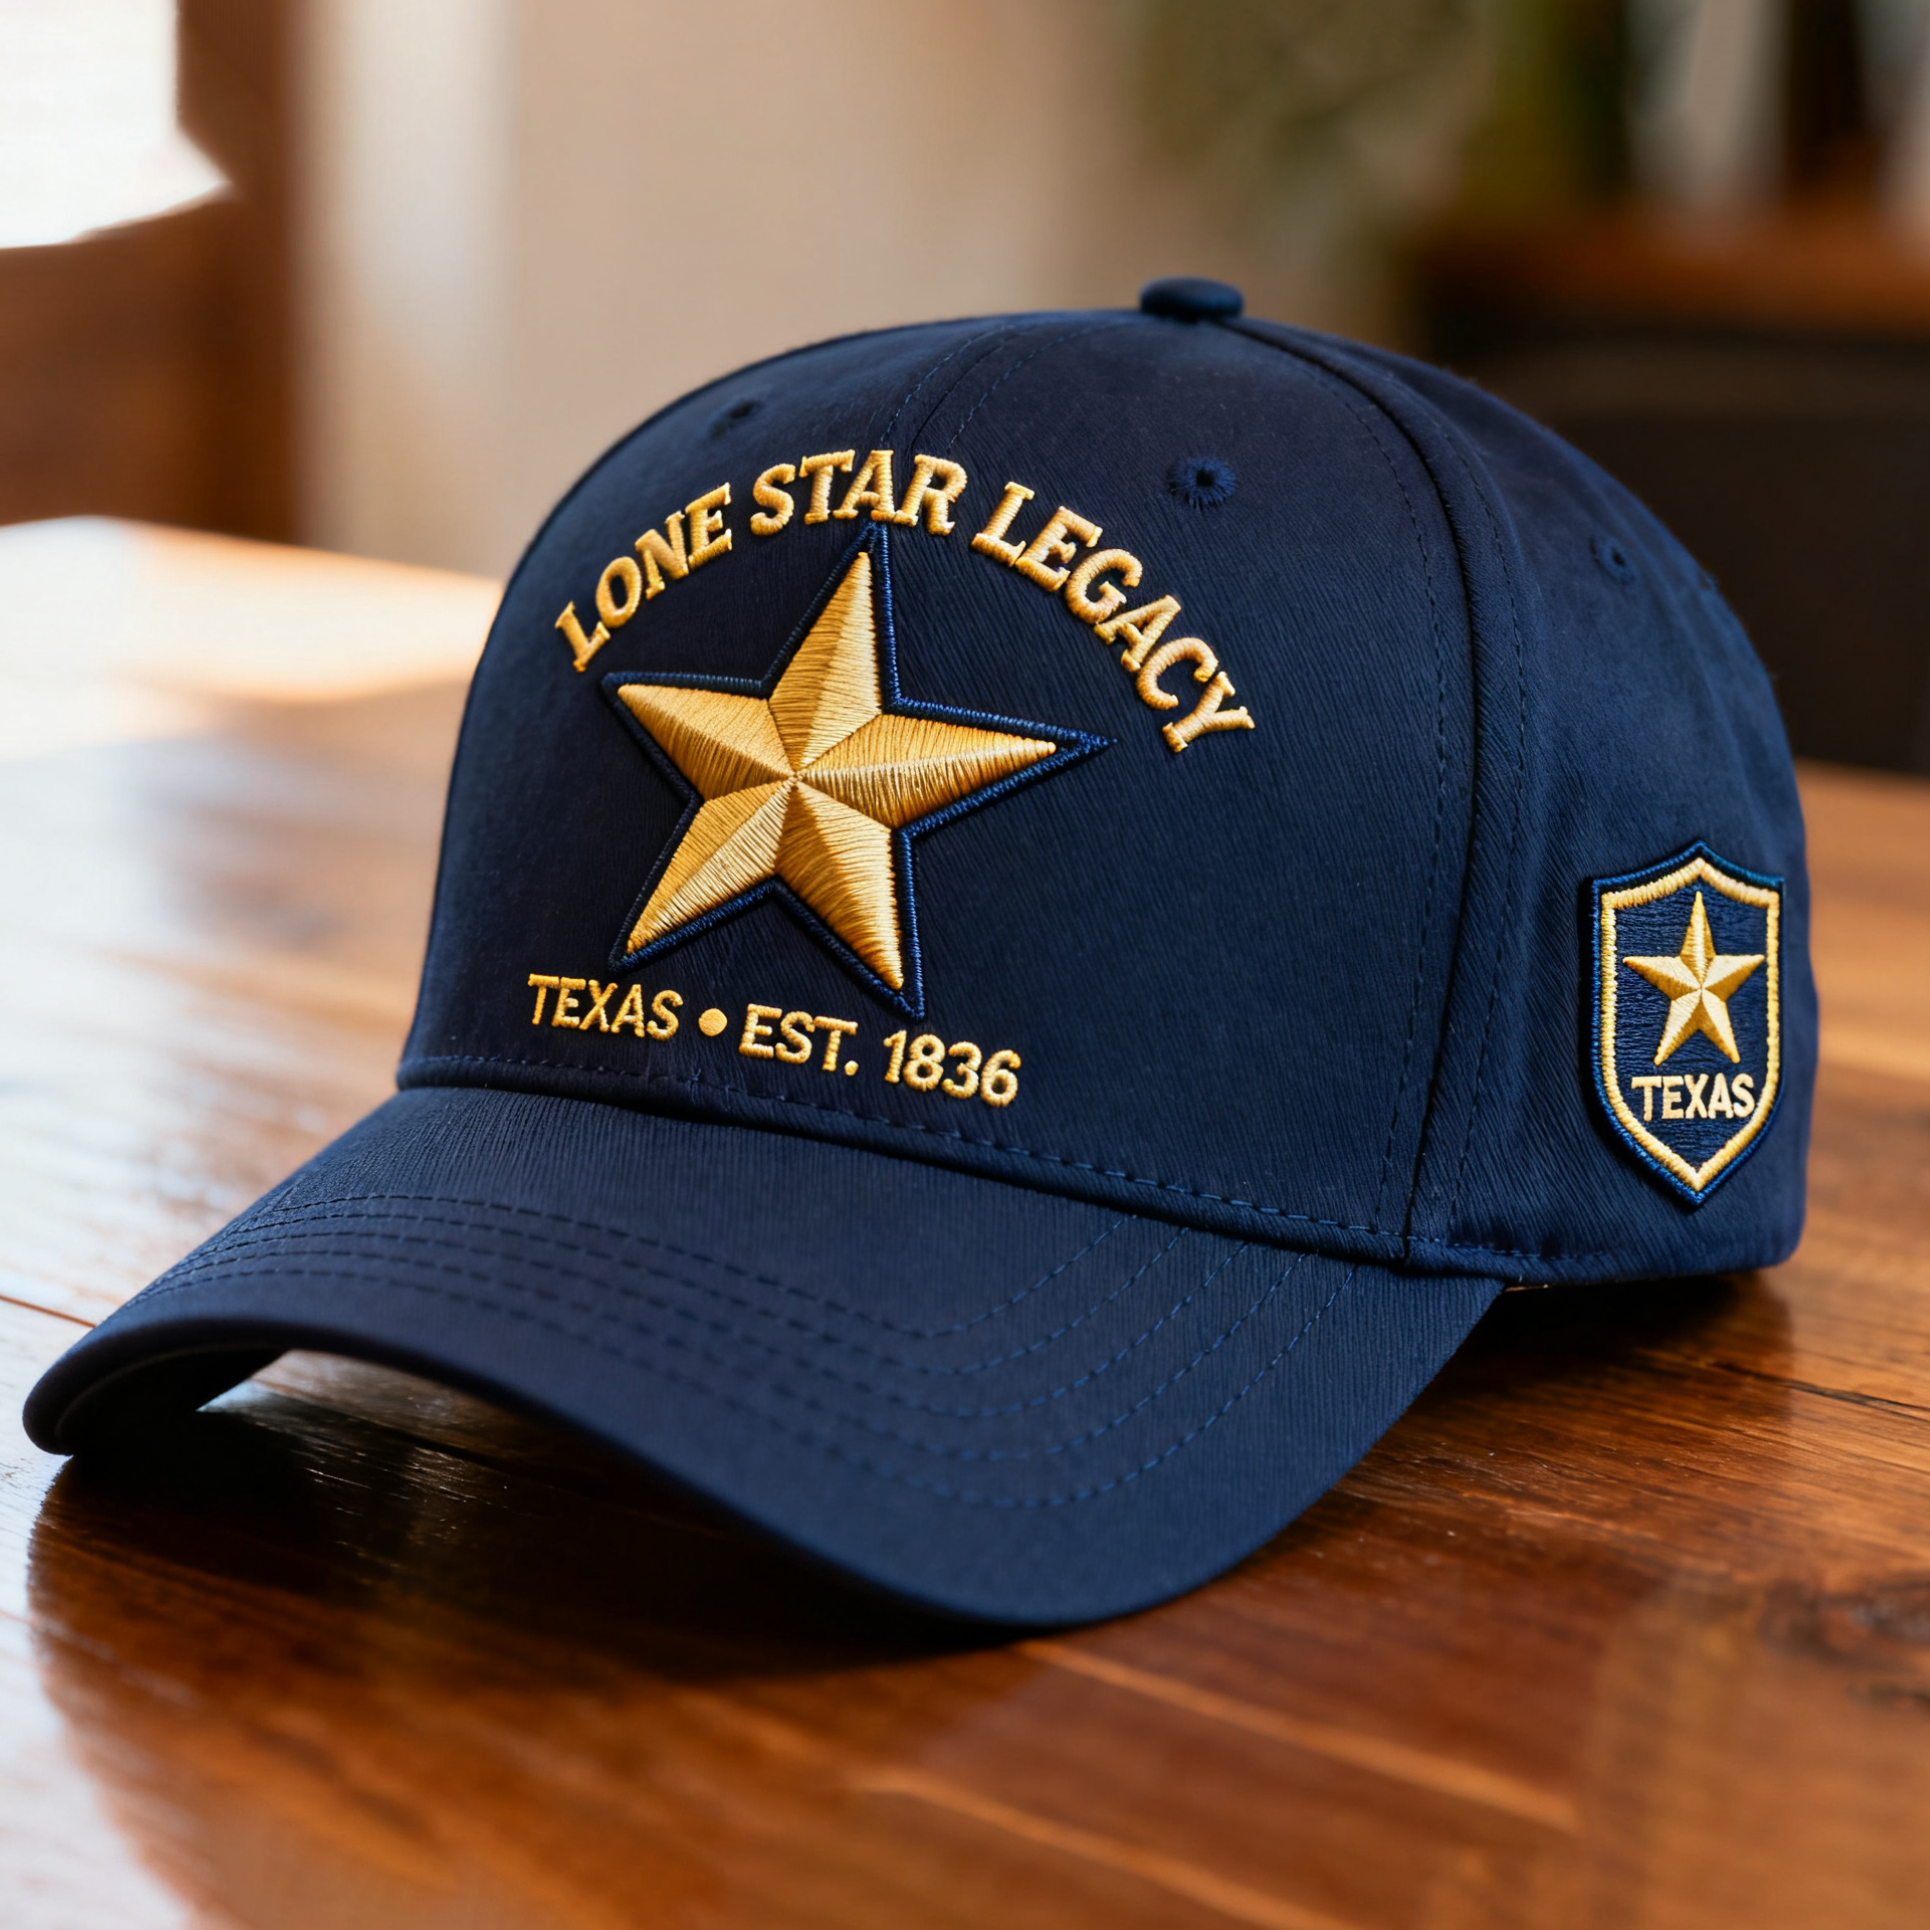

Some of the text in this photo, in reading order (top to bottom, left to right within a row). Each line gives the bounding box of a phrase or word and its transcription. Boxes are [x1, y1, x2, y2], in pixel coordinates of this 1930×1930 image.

[554, 449, 1257, 753] LONE STAR LEGACY
[527, 973, 1022, 1108] TEXAS EST. 1836
[1630, 1073, 1756, 1122] TEXAS
